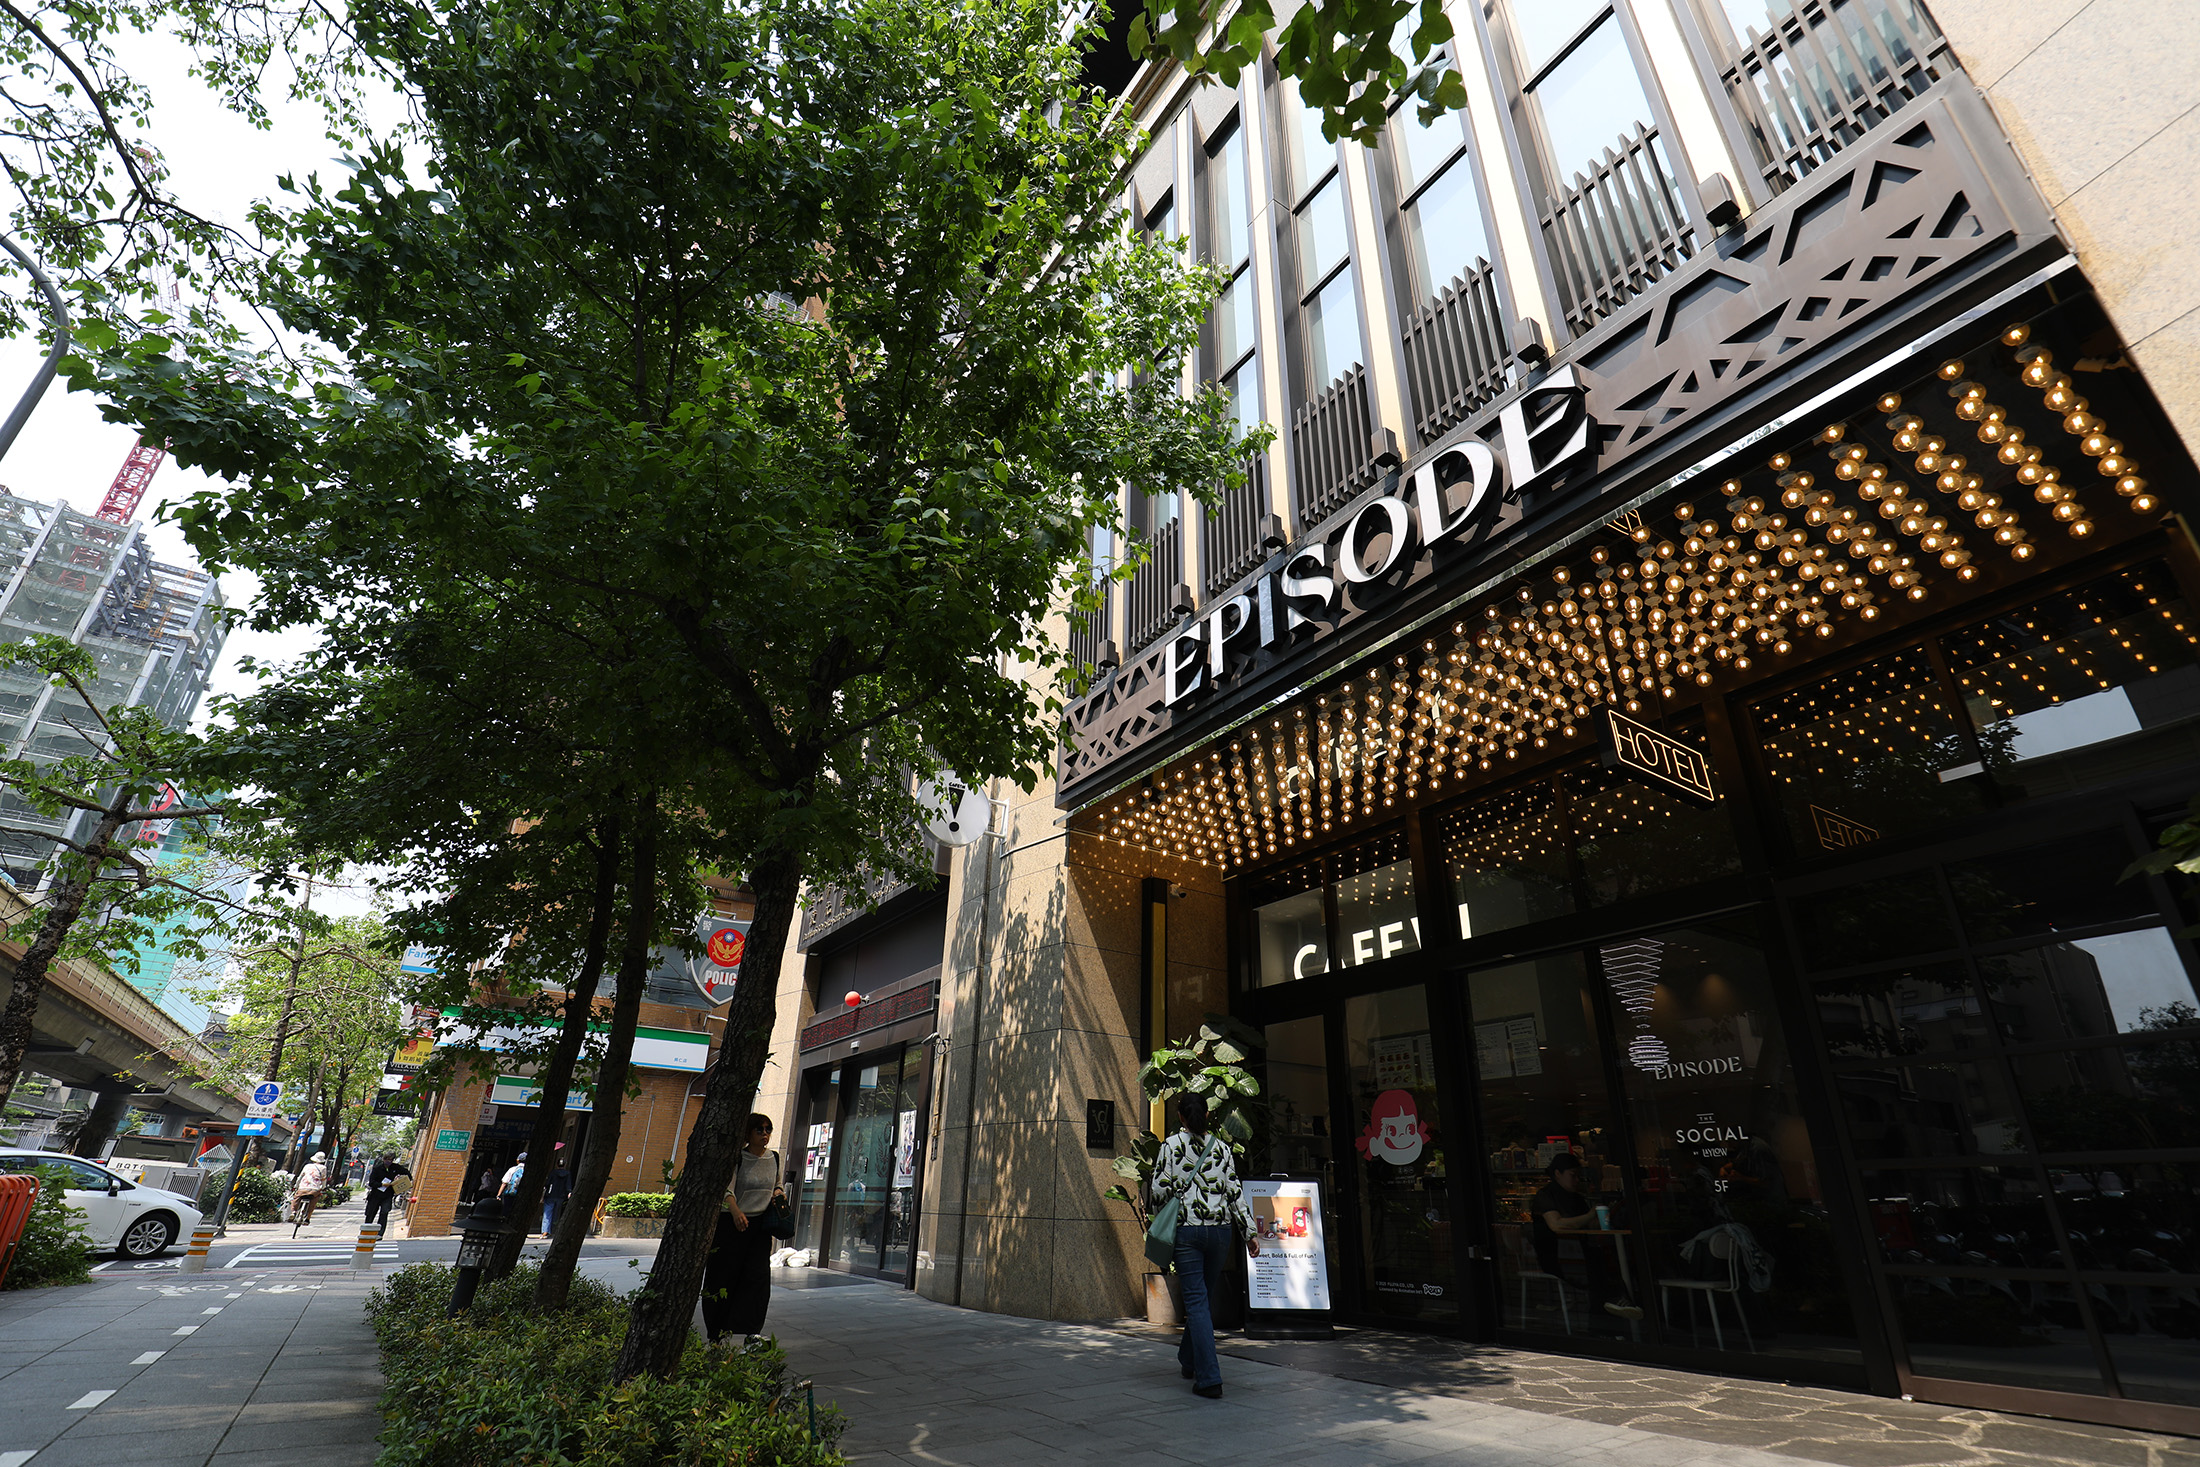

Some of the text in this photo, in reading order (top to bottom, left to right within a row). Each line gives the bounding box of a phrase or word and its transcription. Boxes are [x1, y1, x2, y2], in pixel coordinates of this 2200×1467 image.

[1164, 362, 1590, 707] EPISODE
[1612, 720, 1709, 791] HOTEL
[704, 969, 737, 987] POLIC
[1654, 1056, 1742, 1080] EPISODE
[1676, 1126, 1749, 1143] SOCIAL
[1714, 1180, 1729, 1192] 5F
